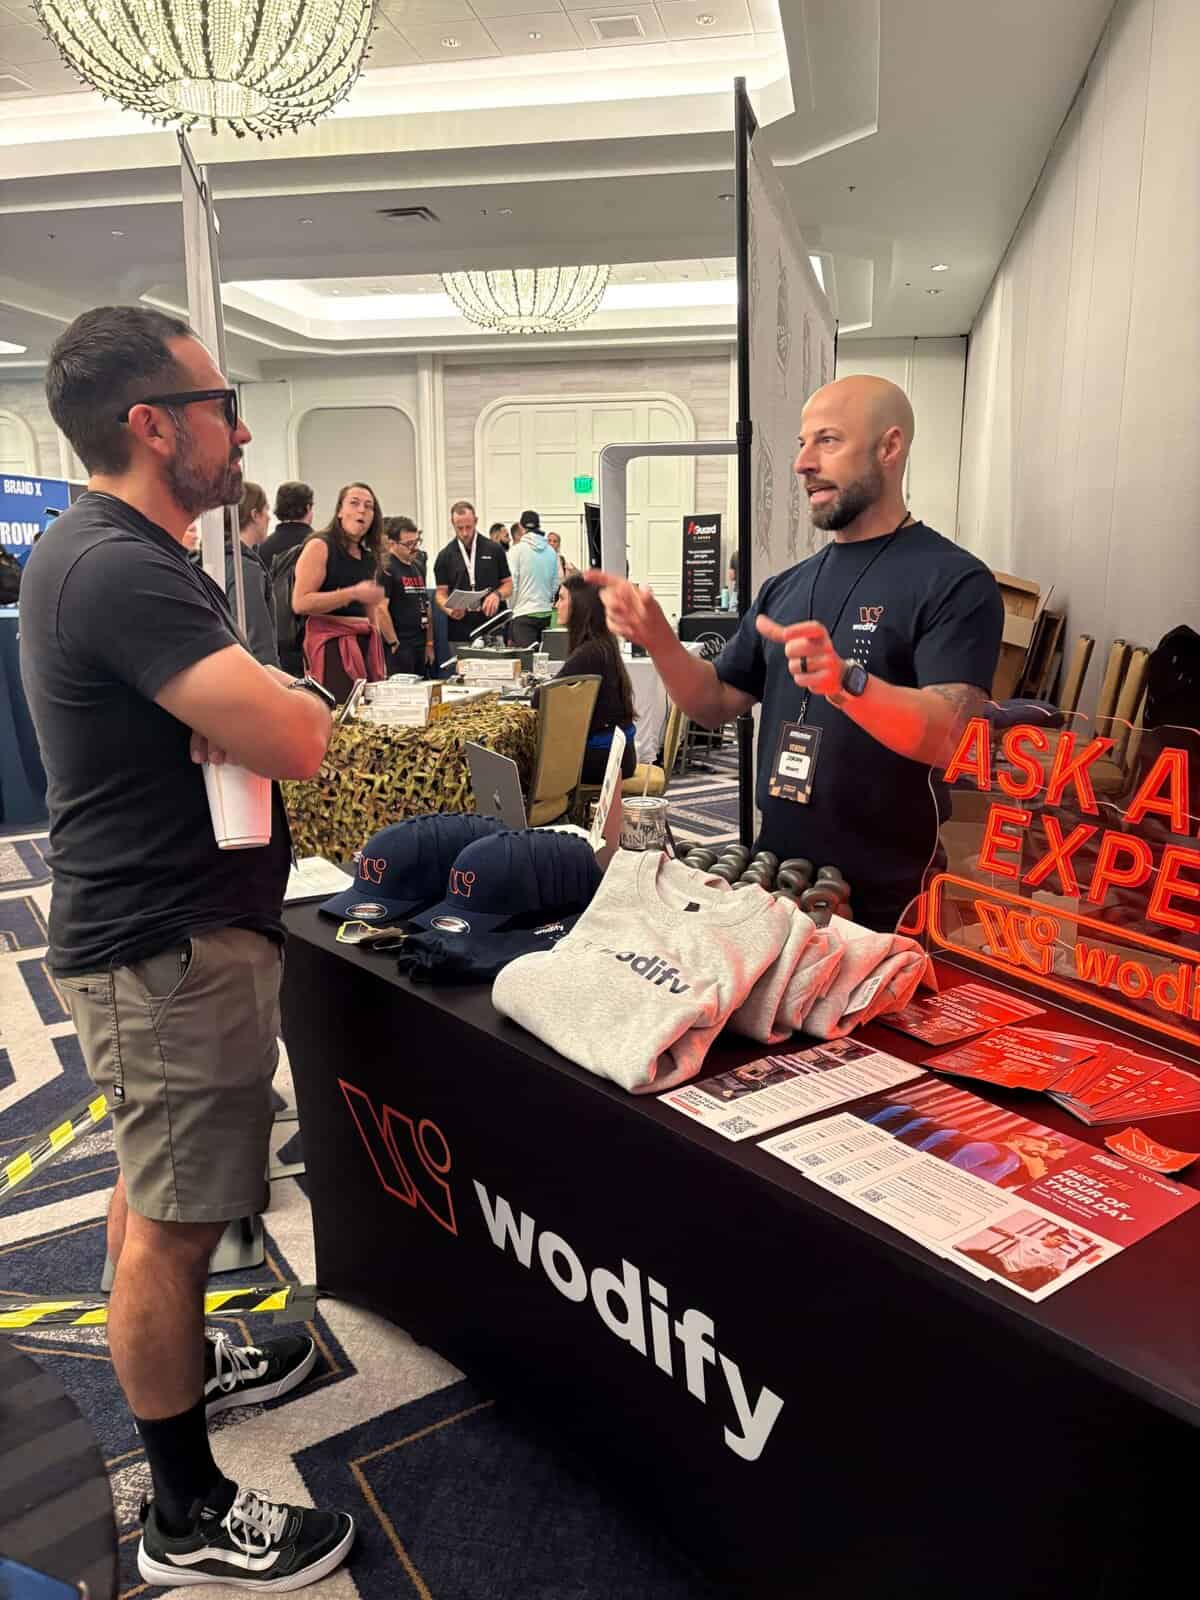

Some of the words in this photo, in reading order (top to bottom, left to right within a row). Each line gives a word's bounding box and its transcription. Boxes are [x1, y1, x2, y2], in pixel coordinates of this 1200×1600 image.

[3, 479, 34, 495] BRAND
[34, 482, 42, 496] X
[943, 717, 1121, 816] ASK
[976, 803, 1200, 935] EXPE
[1044, 1179, 1096, 1205] THEIR
[1094, 1203, 1136, 1222] DAY
[1053, 1174, 1103, 1198] HOUR
[1103, 1196, 1131, 1209] OF
[1062, 1169, 1109, 1189] BEST
[472, 1178, 785, 1462] wodify
